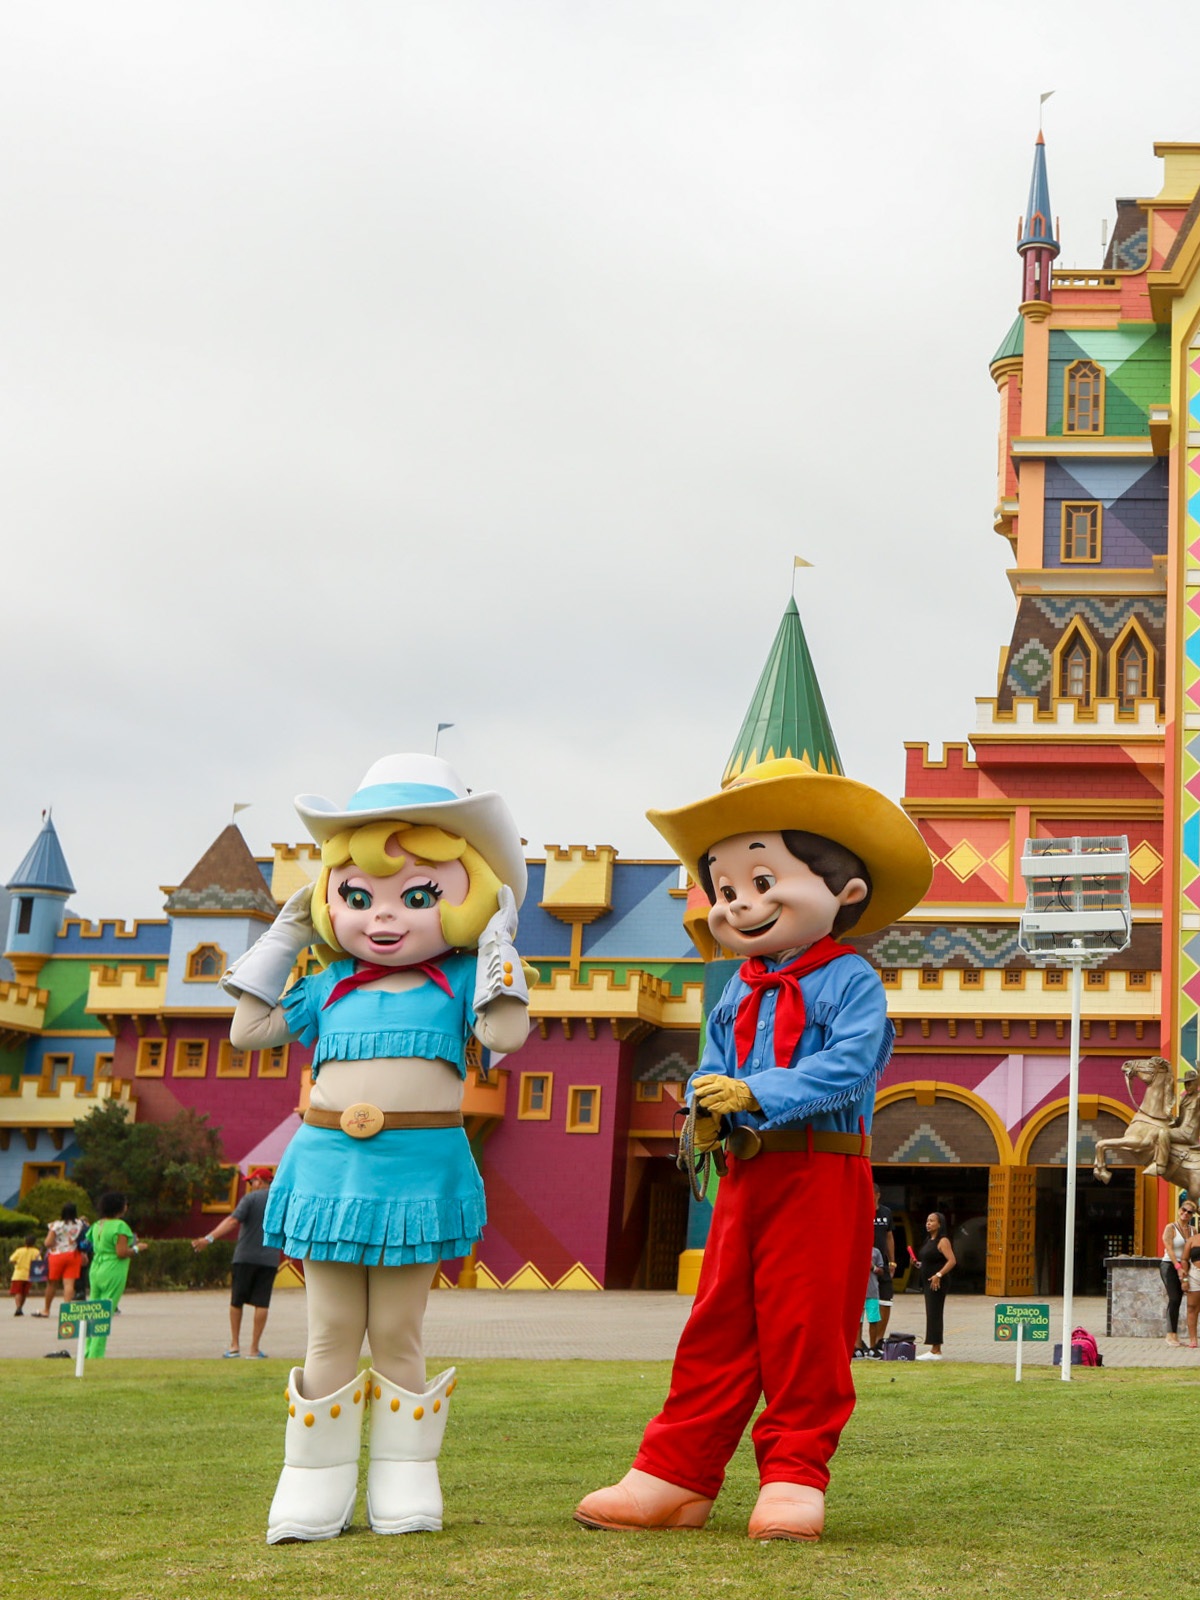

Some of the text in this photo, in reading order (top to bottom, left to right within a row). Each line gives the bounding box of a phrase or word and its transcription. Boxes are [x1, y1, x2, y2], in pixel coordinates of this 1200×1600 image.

[70, 1302, 102, 1313] Espaço
[1006, 1306, 1040, 1317] Espaço
[61, 1309, 110, 1322] Reservado
[997, 1314, 1048, 1325] Reservado
[94, 1323, 109, 1333] SSF
[1032, 1330, 1048, 1339] SSF
